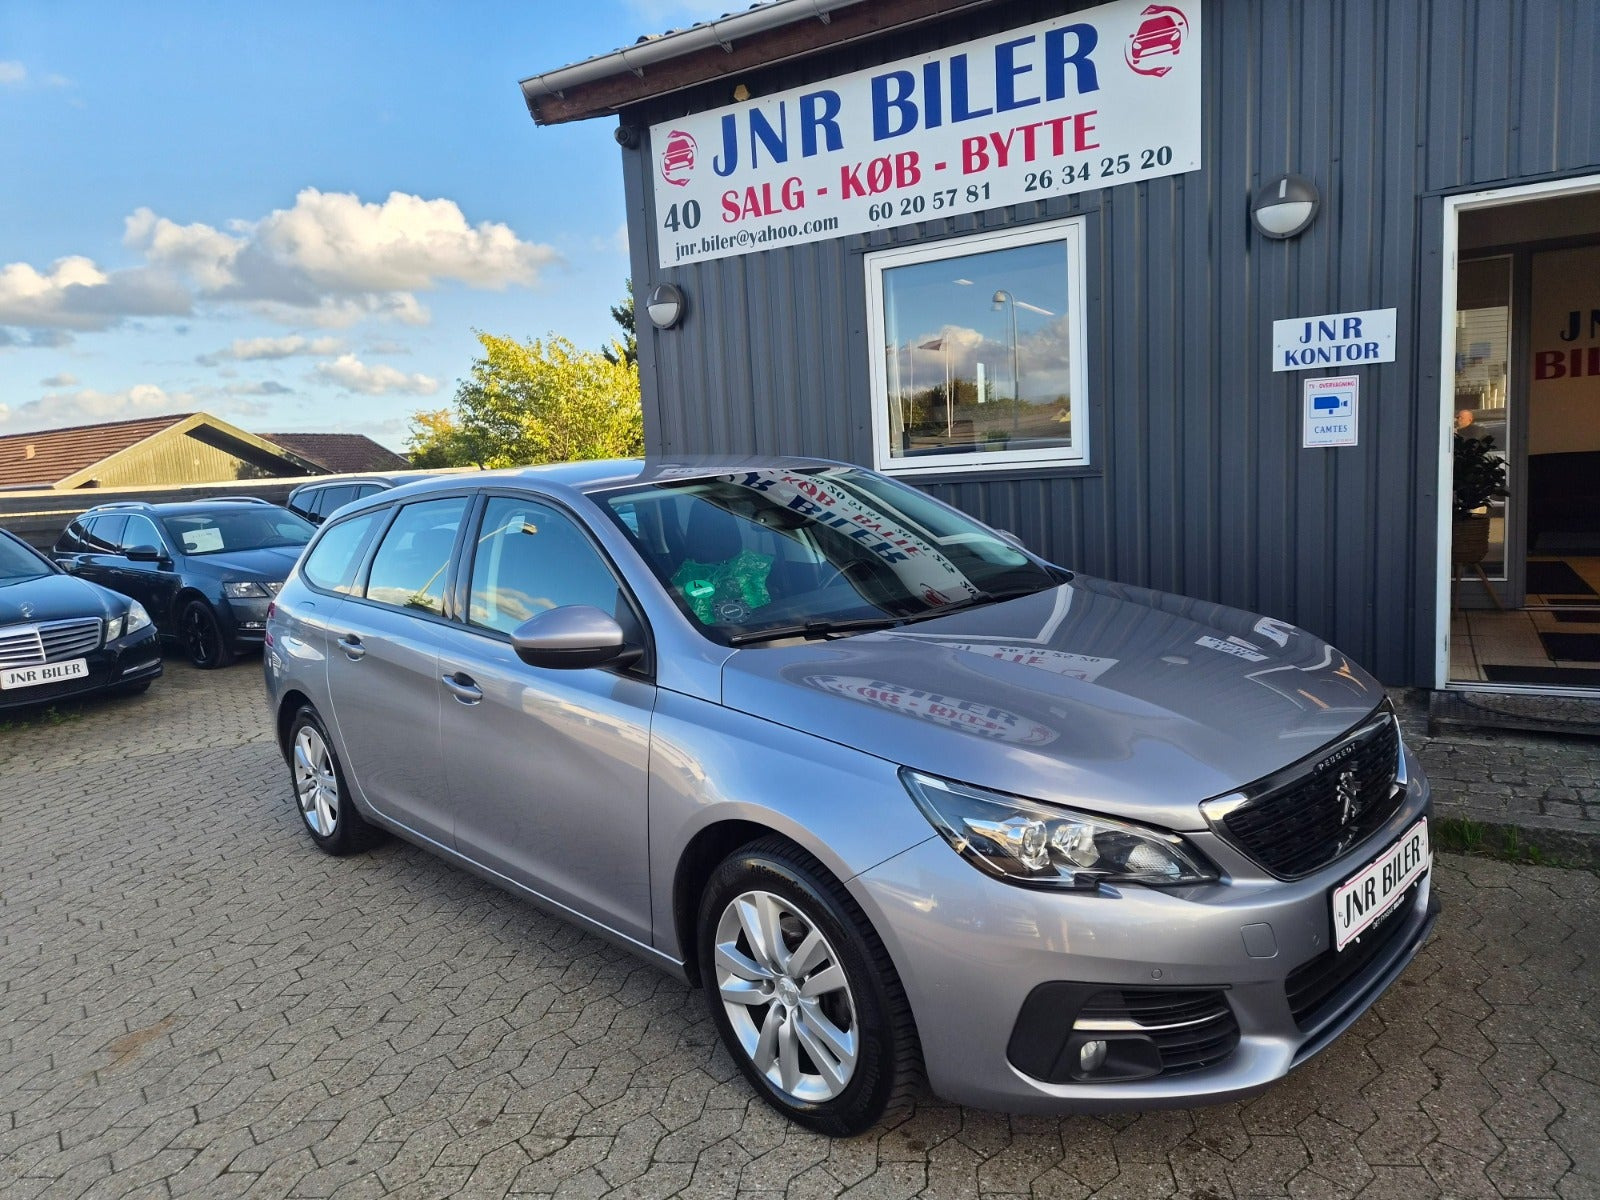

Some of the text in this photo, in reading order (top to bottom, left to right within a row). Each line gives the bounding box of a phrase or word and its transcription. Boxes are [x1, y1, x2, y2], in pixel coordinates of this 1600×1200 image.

[713, 23, 1100, 177] JNR BILER
[721, 110, 1100, 223] SALG - KØB - BYTTE
[1024, 145, 1172, 192] 26 34 25 20
[664, 199, 701, 232] 40
[868, 182, 990, 222] 60 20 57 81
[675, 216, 839, 261] jnr.biler@yahoo.com
[1300, 317, 1363, 344] JNR
[1285, 342, 1379, 366] KONTOR
[1314, 425, 1348, 434] CAMTES
[9, 664, 81, 684] JNR BILER
[1318, 742, 1356, 771] PEUGEOT
[1343, 835, 1421, 929] JNR BILER
